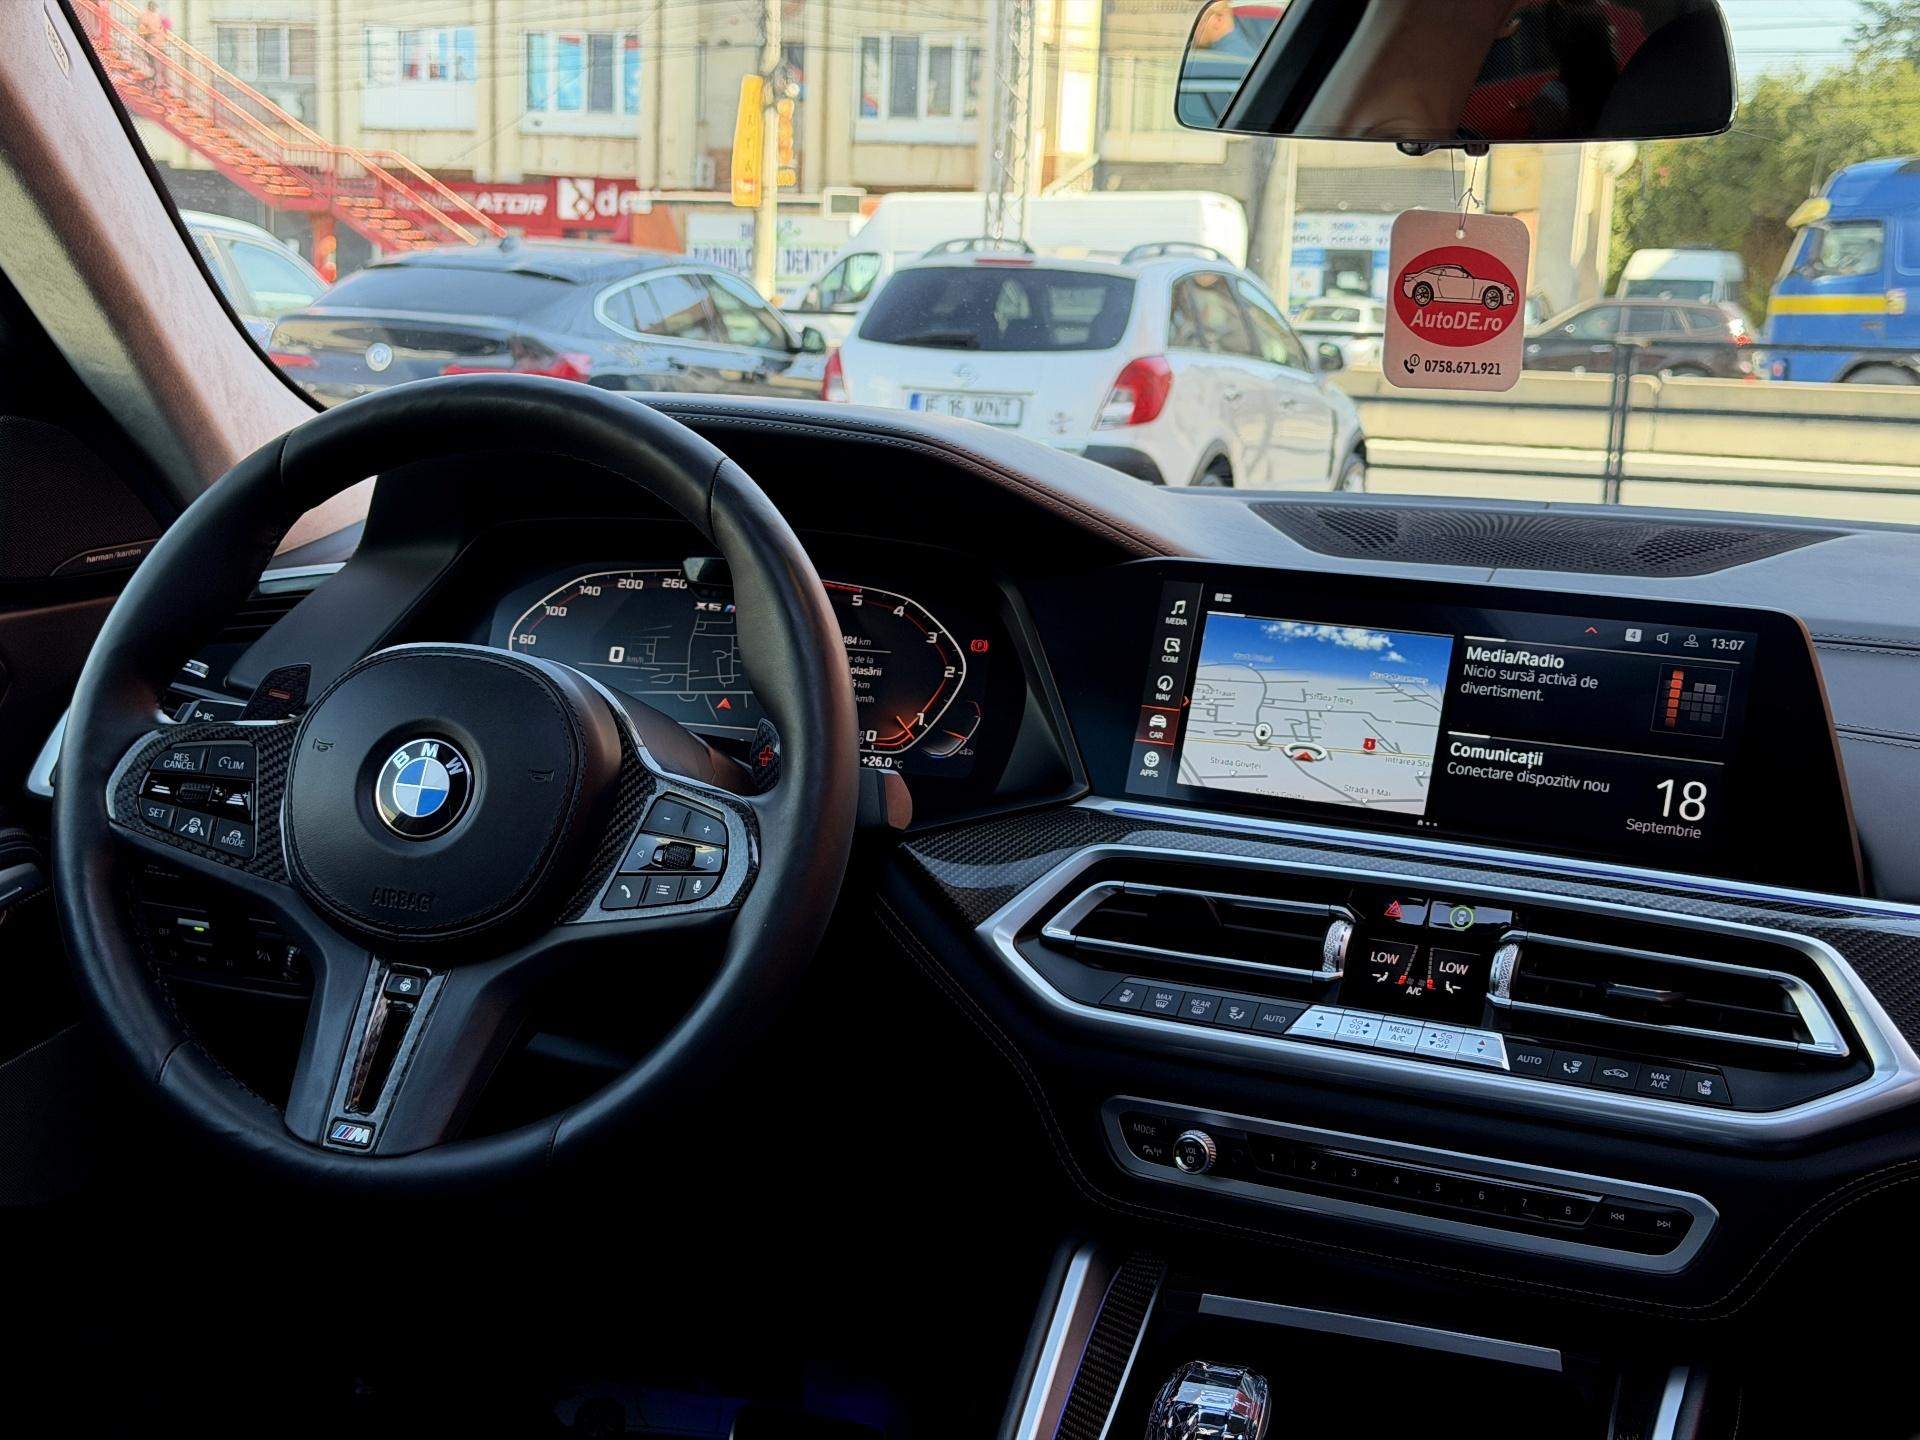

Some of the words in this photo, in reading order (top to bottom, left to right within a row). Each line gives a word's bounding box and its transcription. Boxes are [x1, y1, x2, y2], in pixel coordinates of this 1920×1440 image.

[1410, 309, 1502, 332] AutoDE.ro
[1424, 359, 1502, 376] 0758.671.921
[617, 578, 644, 590] 200
[661, 577, 687, 589] 260
[579, 584, 601, 597] 140
[694, 601, 722, 612] X6
[851, 594, 863, 607] 5
[545, 605, 568, 617] 100
[893, 605, 904, 617] 4
[1165, 616, 1188, 626] MEDIA
[518, 634, 537, 645] 60
[858, 636, 872, 646] km
[926, 631, 938, 643] 3
[1711, 638, 1745, 651] 13:07
[608, 646, 625, 663] 0
[1161, 654, 1179, 663] COM
[1466, 647, 1565, 669] Media/Radio
[944, 665, 956, 678] 2
[1463, 664, 1496, 680] Nicio
[1499, 667, 1535, 682] sursă
[1538, 671, 1577, 687] activă
[1580, 675, 1599, 689] de
[857, 680, 870, 689] km
[1155, 692, 1170, 702] NAV
[1460, 682, 1544, 702] divertisment.
[203, 712, 214, 722] BC
[916, 712, 925, 726] 1
[865, 729, 877, 742] 0
[1149, 730, 1164, 739] CAR
[173, 753, 190, 763] RES
[392, 743, 464, 776] BMW
[861, 756, 892, 768] +26.0
[1210, 757, 1234, 767] Strada
[1385, 757, 1416, 767] Intrarea
[1450, 743, 1544, 769] Comunicații
[163, 759, 196, 771] CANCEL
[228, 761, 245, 770] LIM
[1140, 768, 1159, 778] APPS
[1447, 762, 1514, 781] Conectare
[1517, 769, 1580, 788] dispozitiv
[1583, 779, 1610, 792] nou
[1343, 784, 1368, 795] Strada
[1656, 778, 1707, 822] 18
[148, 807, 166, 819] SET
[1625, 818, 1702, 839] Septembrie
[221, 835, 246, 848] MODE
[1370, 951, 1399, 965] LOW
[1438, 961, 1469, 976] LOW
[1405, 985, 1422, 996] A/C
[1155, 993, 1173, 1001] MAX
[1190, 999, 1211, 1009] REAR
[1262, 1013, 1286, 1024] AUTO
[1388, 1025, 1413, 1035] MENU
[1516, 1054, 1542, 1065] AUTO
[1650, 1072, 1671, 1082] MAX
[1650, 1080, 1669, 1089] A/C
[1132, 1122, 1157, 1136] MODE
[1184, 1145, 1197, 1155] VOL
